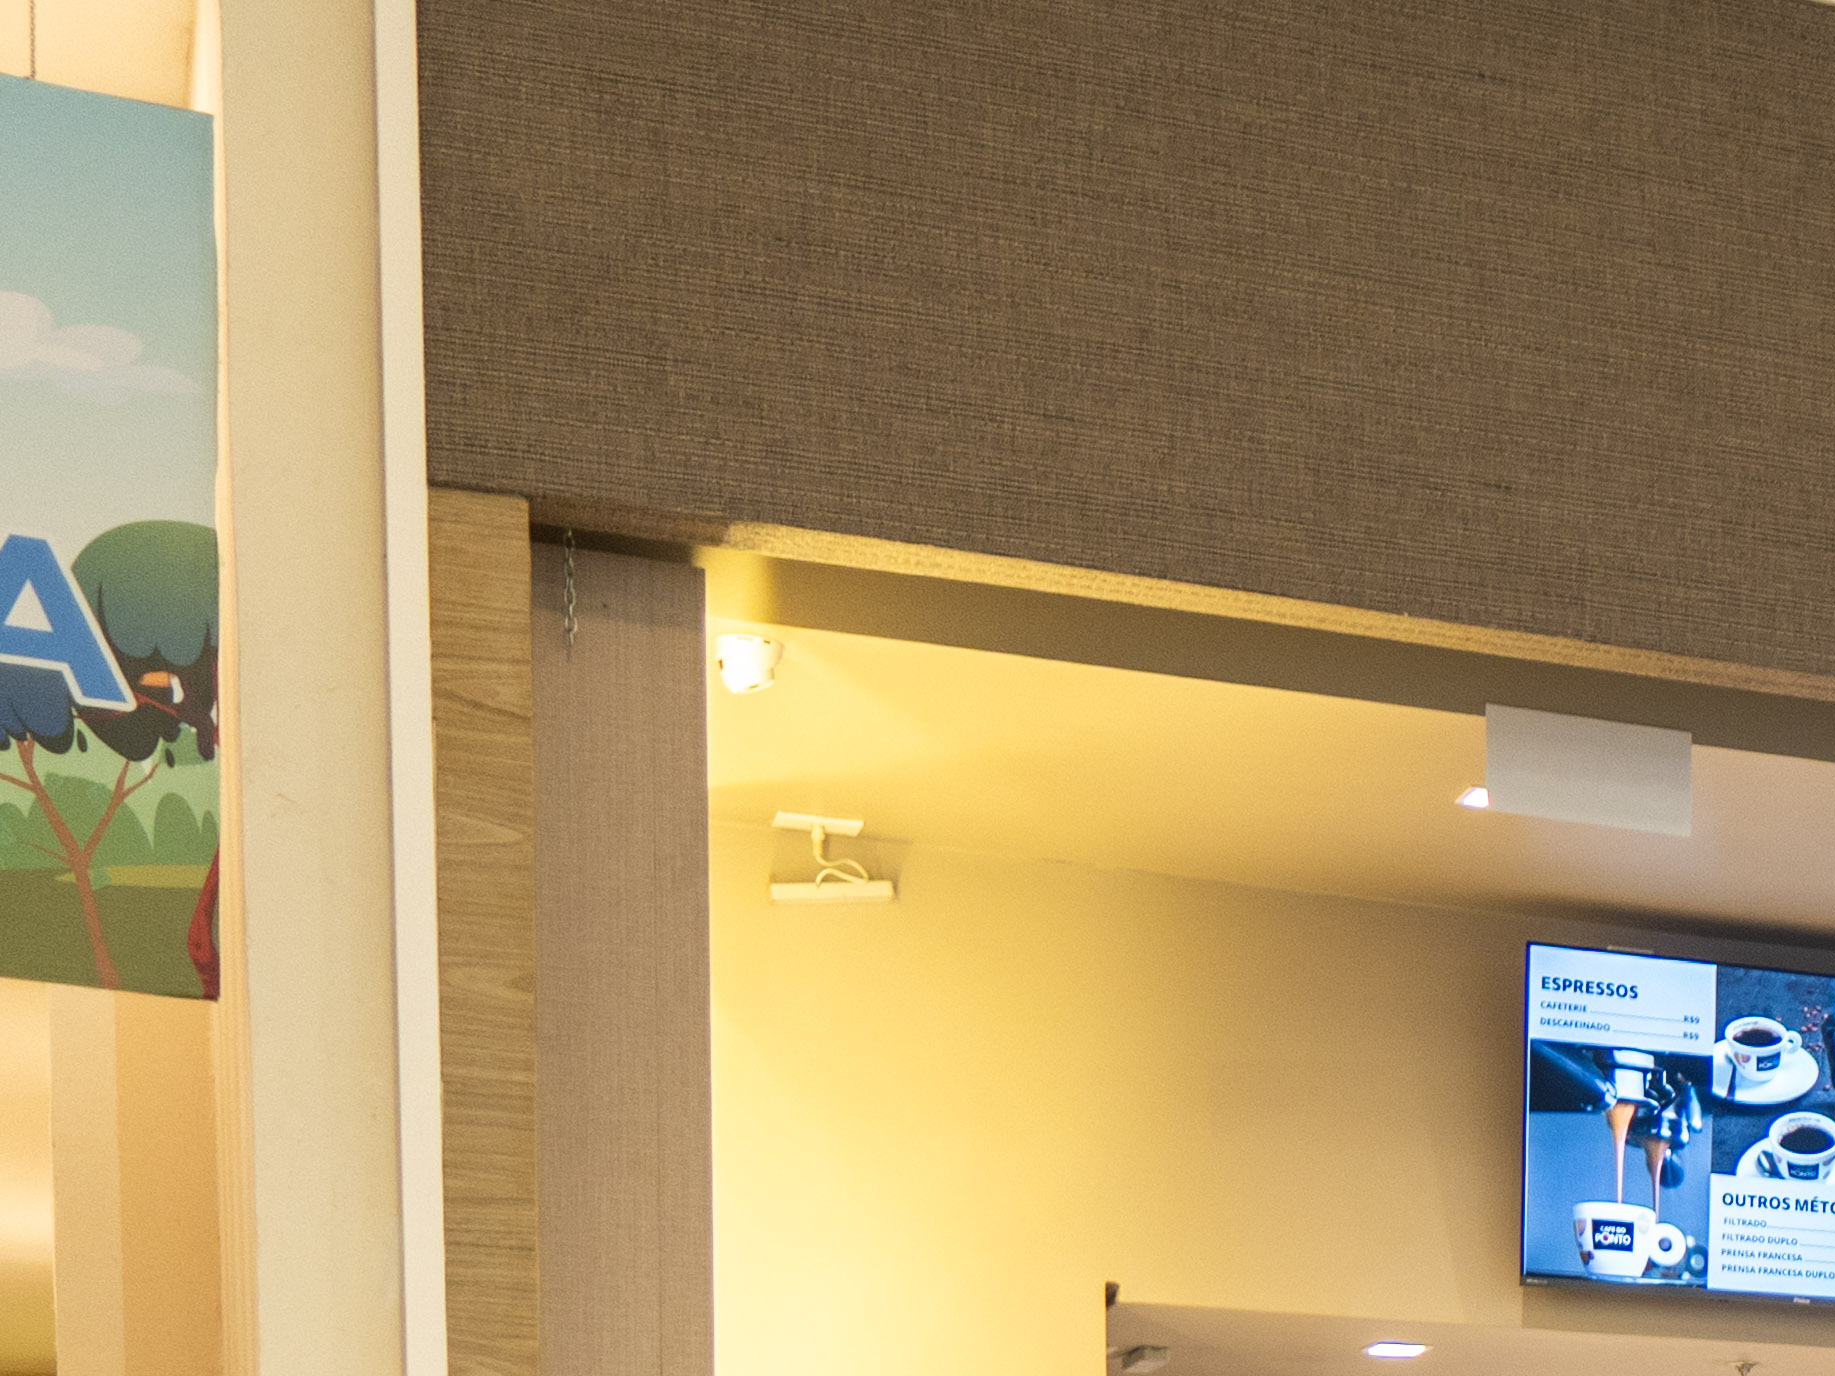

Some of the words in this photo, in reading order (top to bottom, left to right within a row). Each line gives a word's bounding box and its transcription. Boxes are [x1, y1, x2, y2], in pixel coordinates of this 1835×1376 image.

[1542, 976, 1638, 999] ESPRESSOS
[1540, 1017, 1610, 1031] DESCAFEINADO
[1722, 1193, 1791, 1210] OUTROS
[1723, 1217, 1767, 1228] FILTRADO
[1722, 1233, 1765, 1243] FILTRADO
[1721, 1248, 1755, 1258] PRENSA
[1758, 1251, 1802, 1262] FRANCESA
[1721, 1264, 1756, 1274] PRENSA
[1758, 1266, 1803, 1277] FRANCESA
[1806, 1271, 1835, 1279] DUPLO
